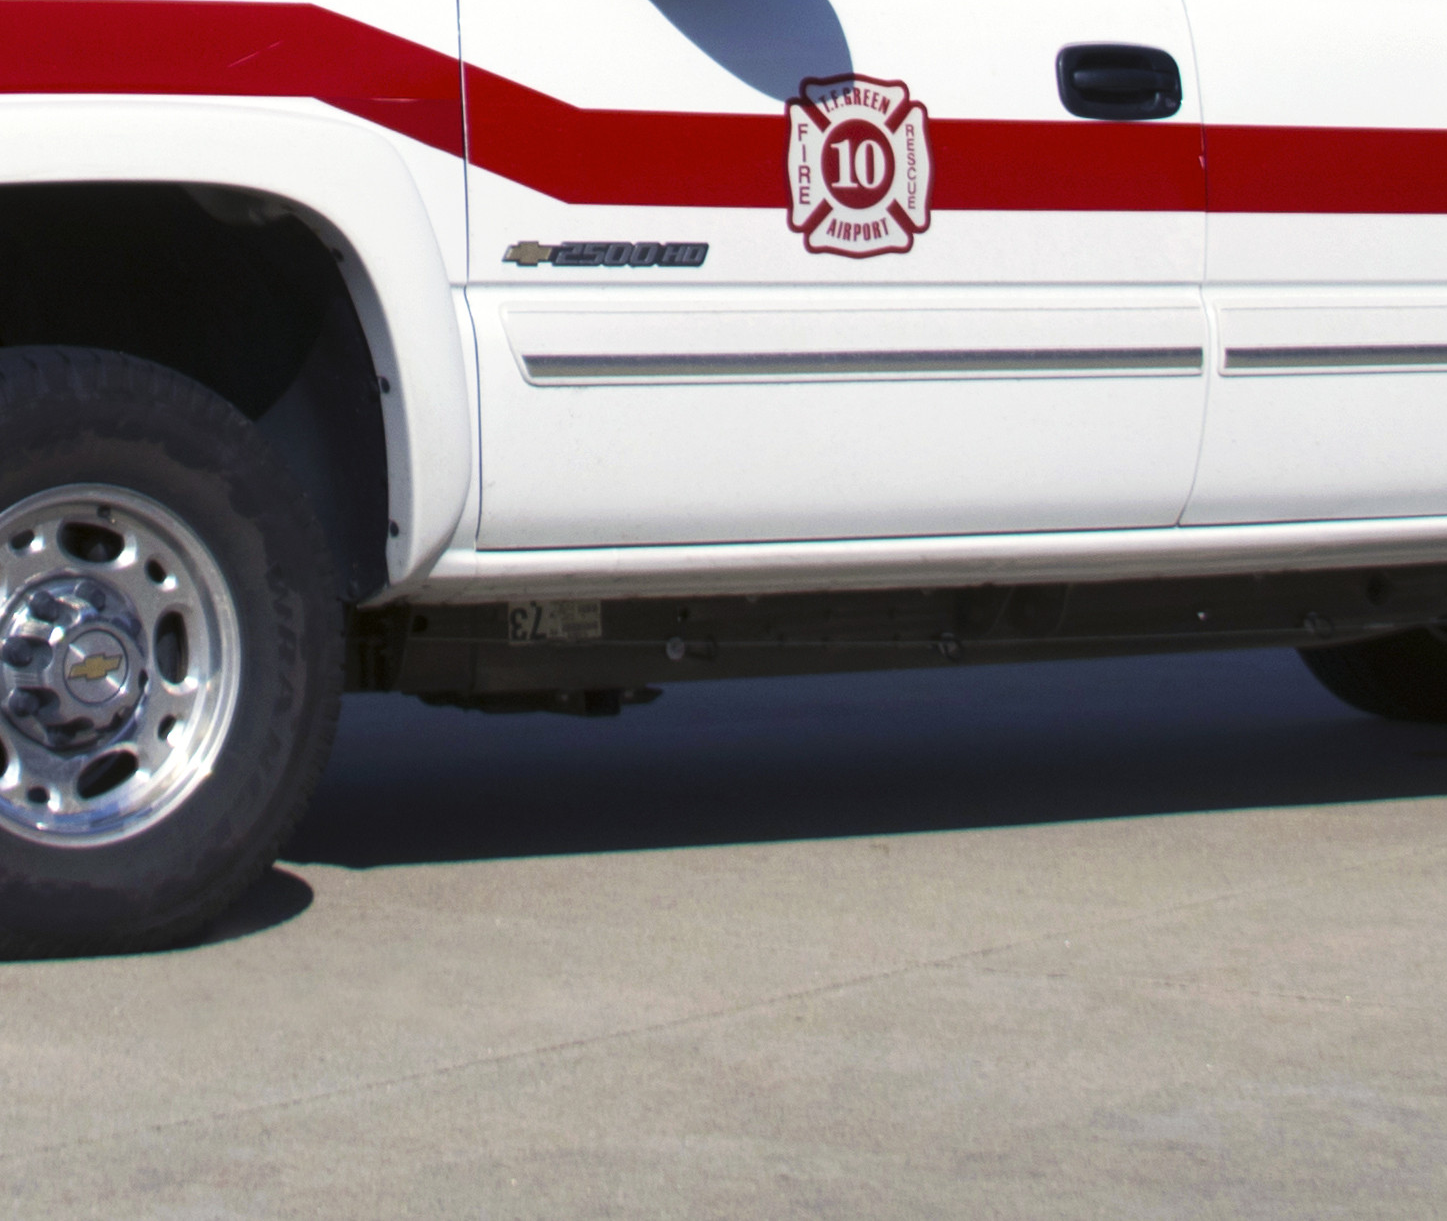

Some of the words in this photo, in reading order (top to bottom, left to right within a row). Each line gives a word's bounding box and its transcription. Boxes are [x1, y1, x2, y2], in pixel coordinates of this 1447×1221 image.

[797, 123, 811, 205] FIRE
[829, 138, 886, 190] 10
[904, 123, 917, 210] RESCUE
[825, 217, 890, 242] AIRPORT
